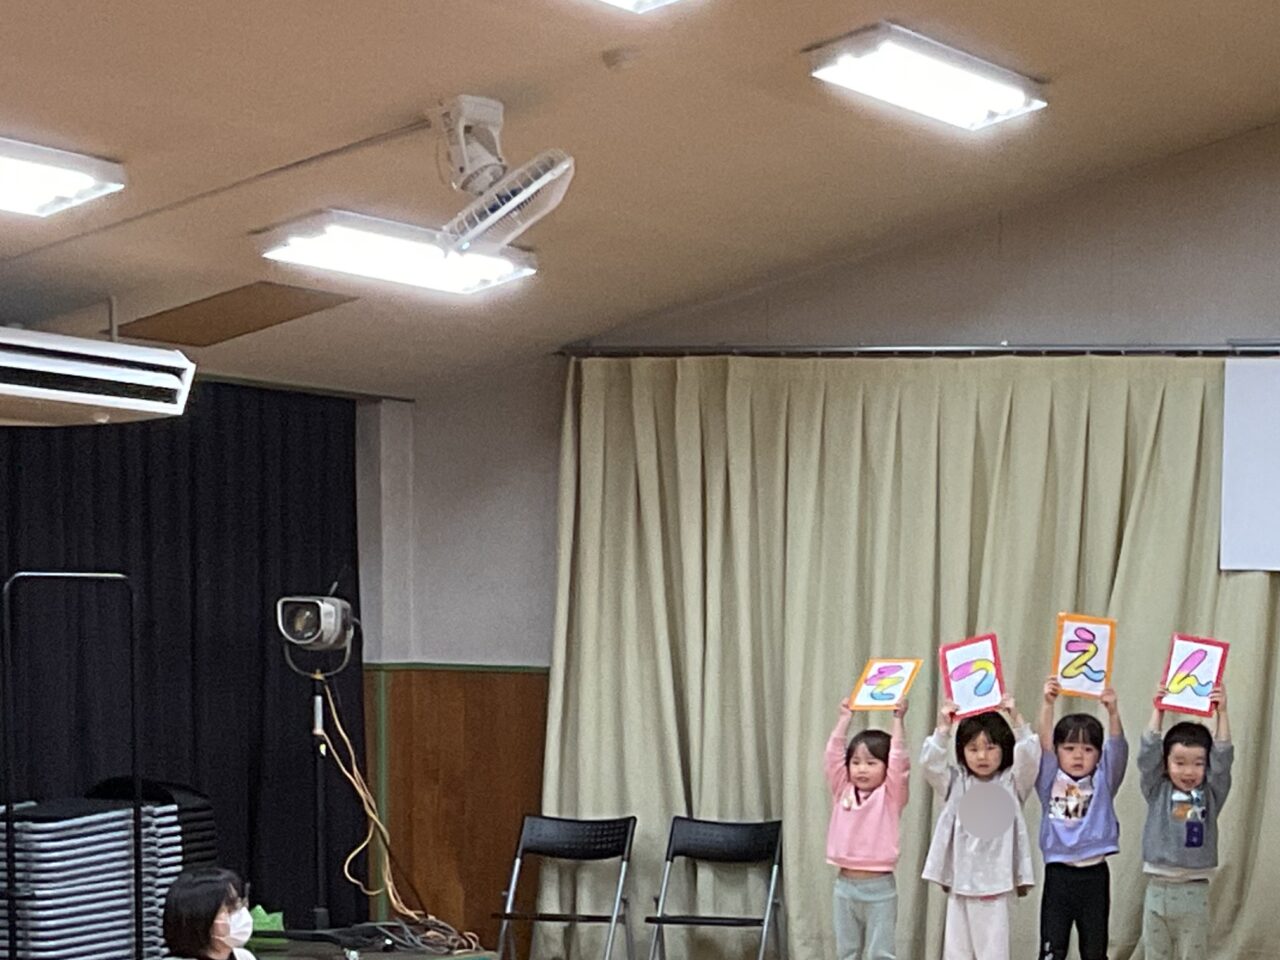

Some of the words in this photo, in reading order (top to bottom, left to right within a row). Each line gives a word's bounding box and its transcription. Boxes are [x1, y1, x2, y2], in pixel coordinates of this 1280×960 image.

[1061, 626, 1106, 683] え
[1167, 648, 1214, 697] ん
[865, 664, 904, 701] そ
[949, 658, 996, 697] つ
